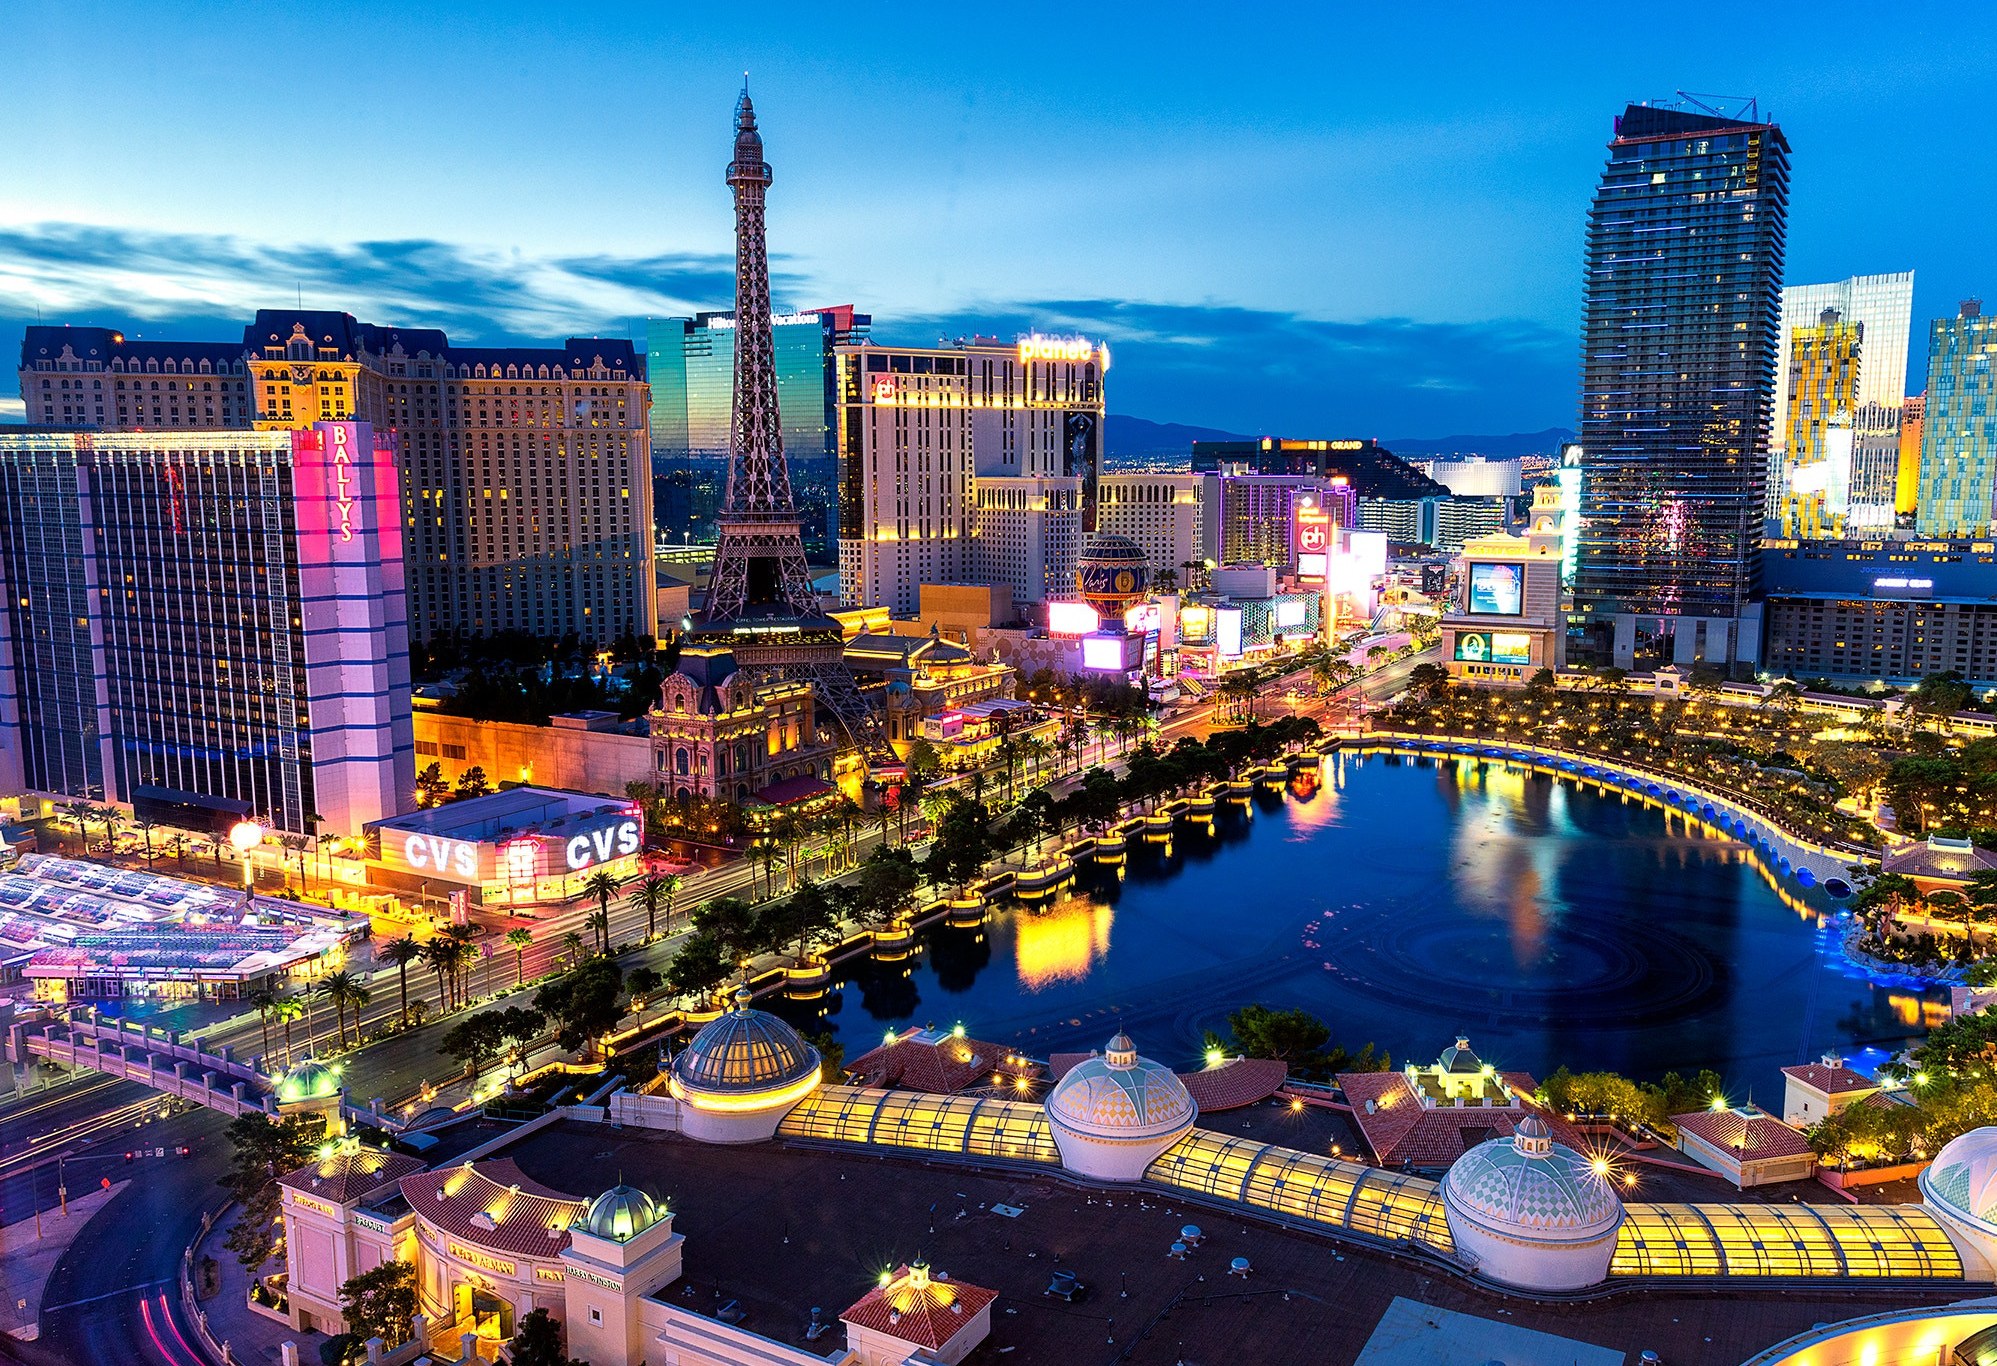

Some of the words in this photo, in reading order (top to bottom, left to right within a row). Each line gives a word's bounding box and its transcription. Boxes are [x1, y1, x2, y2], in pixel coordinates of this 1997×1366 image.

[769, 313, 819, 326] Vacations
[1018, 333, 1093, 364] planet
[1331, 440, 1363, 451] GRAND
[405, 834, 477, 877] CVS
[566, 821, 640, 870] CVS
[479, 1256, 515, 1275] ARMANI
[565, 1264, 588, 1281] HARRY
[587, 1273, 623, 1292] WINSTON
